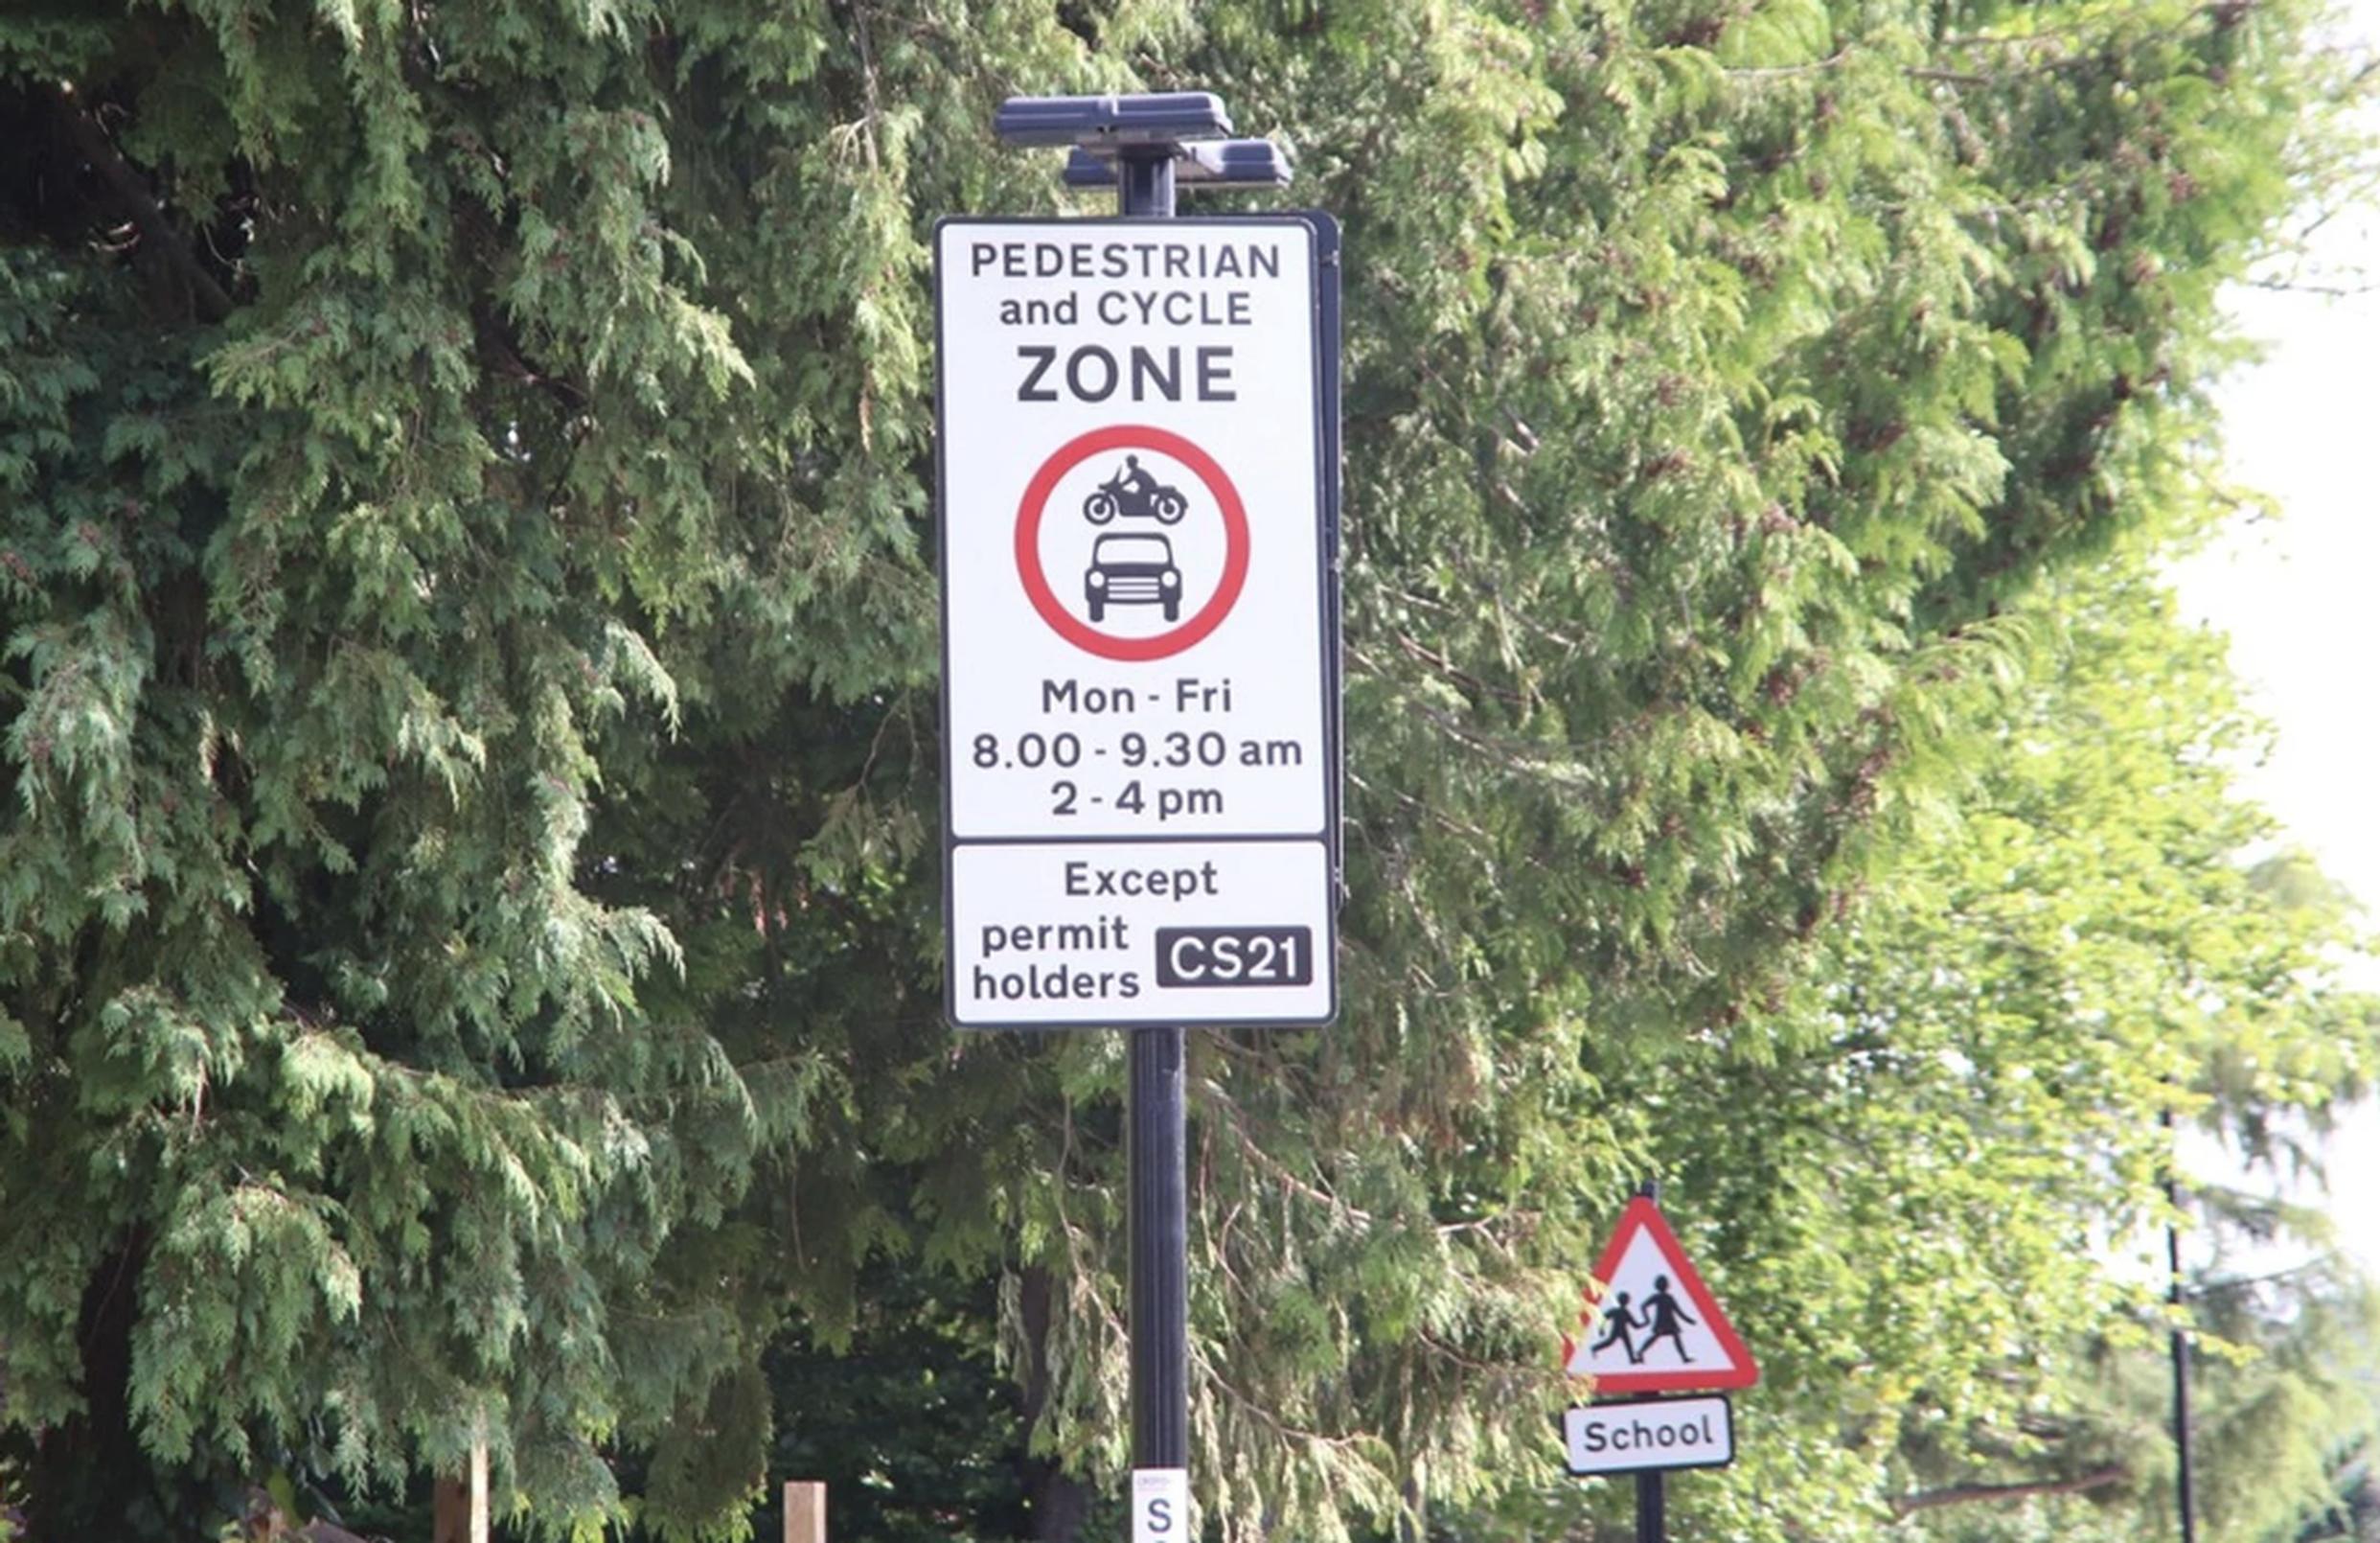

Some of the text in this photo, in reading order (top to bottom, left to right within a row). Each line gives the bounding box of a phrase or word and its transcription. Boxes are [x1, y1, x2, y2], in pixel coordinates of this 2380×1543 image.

[972, 243, 1278, 278] PEDESTRIAN
[1000, 290, 1251, 326] and CYCLE
[1018, 345, 1236, 403] ZONE
[1042, 679, 1134, 714] Mon
[1177, 679, 1231, 712] Fri
[973, 732, 1081, 769] 8.00
[1121, 731, 1225, 768] 9.30
[1240, 741, 1302, 766] am
[1051, 781, 1077, 816] 2
[1115, 781, 1145, 815] 4
[1159, 789, 1223, 821] pm
[1065, 862, 1218, 902] Except
[982, 915, 1129, 958] permit
[1170, 935, 1296, 980] CS21
[973, 964, 1140, 1000] holders
[1585, 1416, 1713, 1453] School
